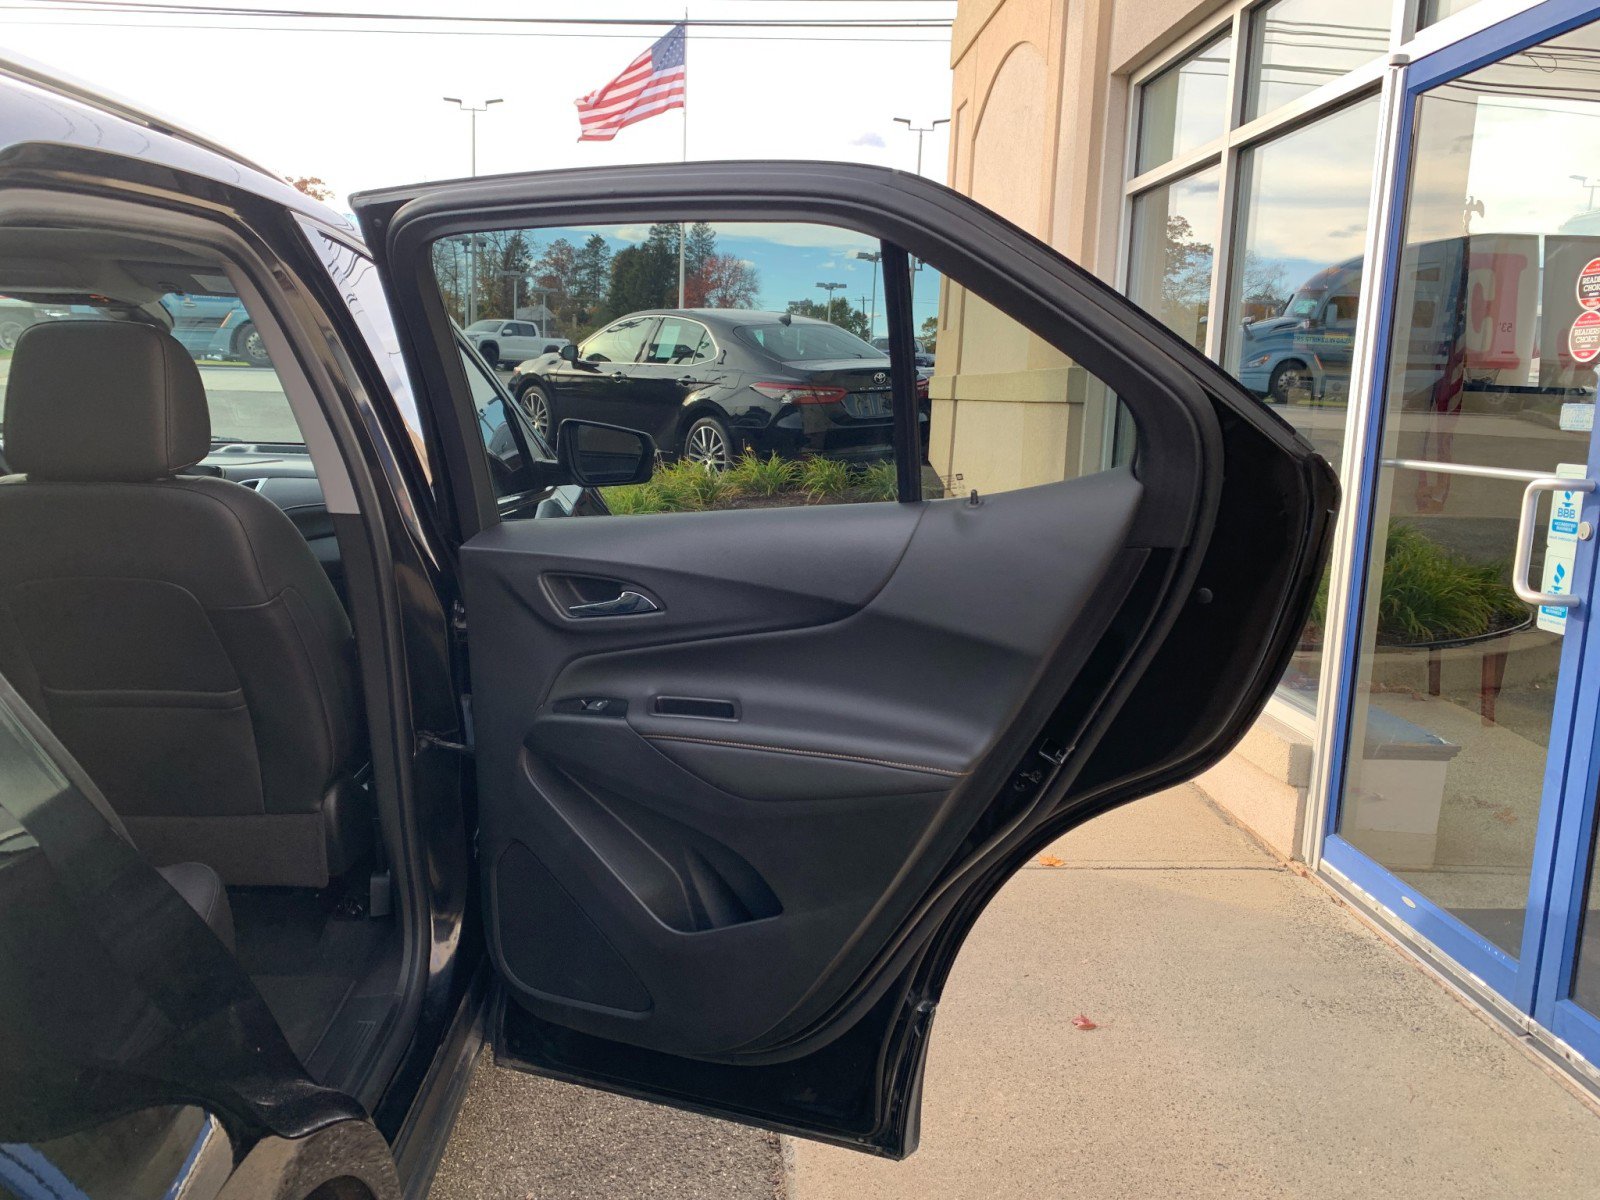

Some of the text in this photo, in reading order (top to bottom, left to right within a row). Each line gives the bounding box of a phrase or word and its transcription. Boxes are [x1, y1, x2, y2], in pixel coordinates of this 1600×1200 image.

[1582, 276, 1600, 284] READE
[1575, 335, 1599, 344] CHOICE
[1558, 507, 1576, 519] BBB
